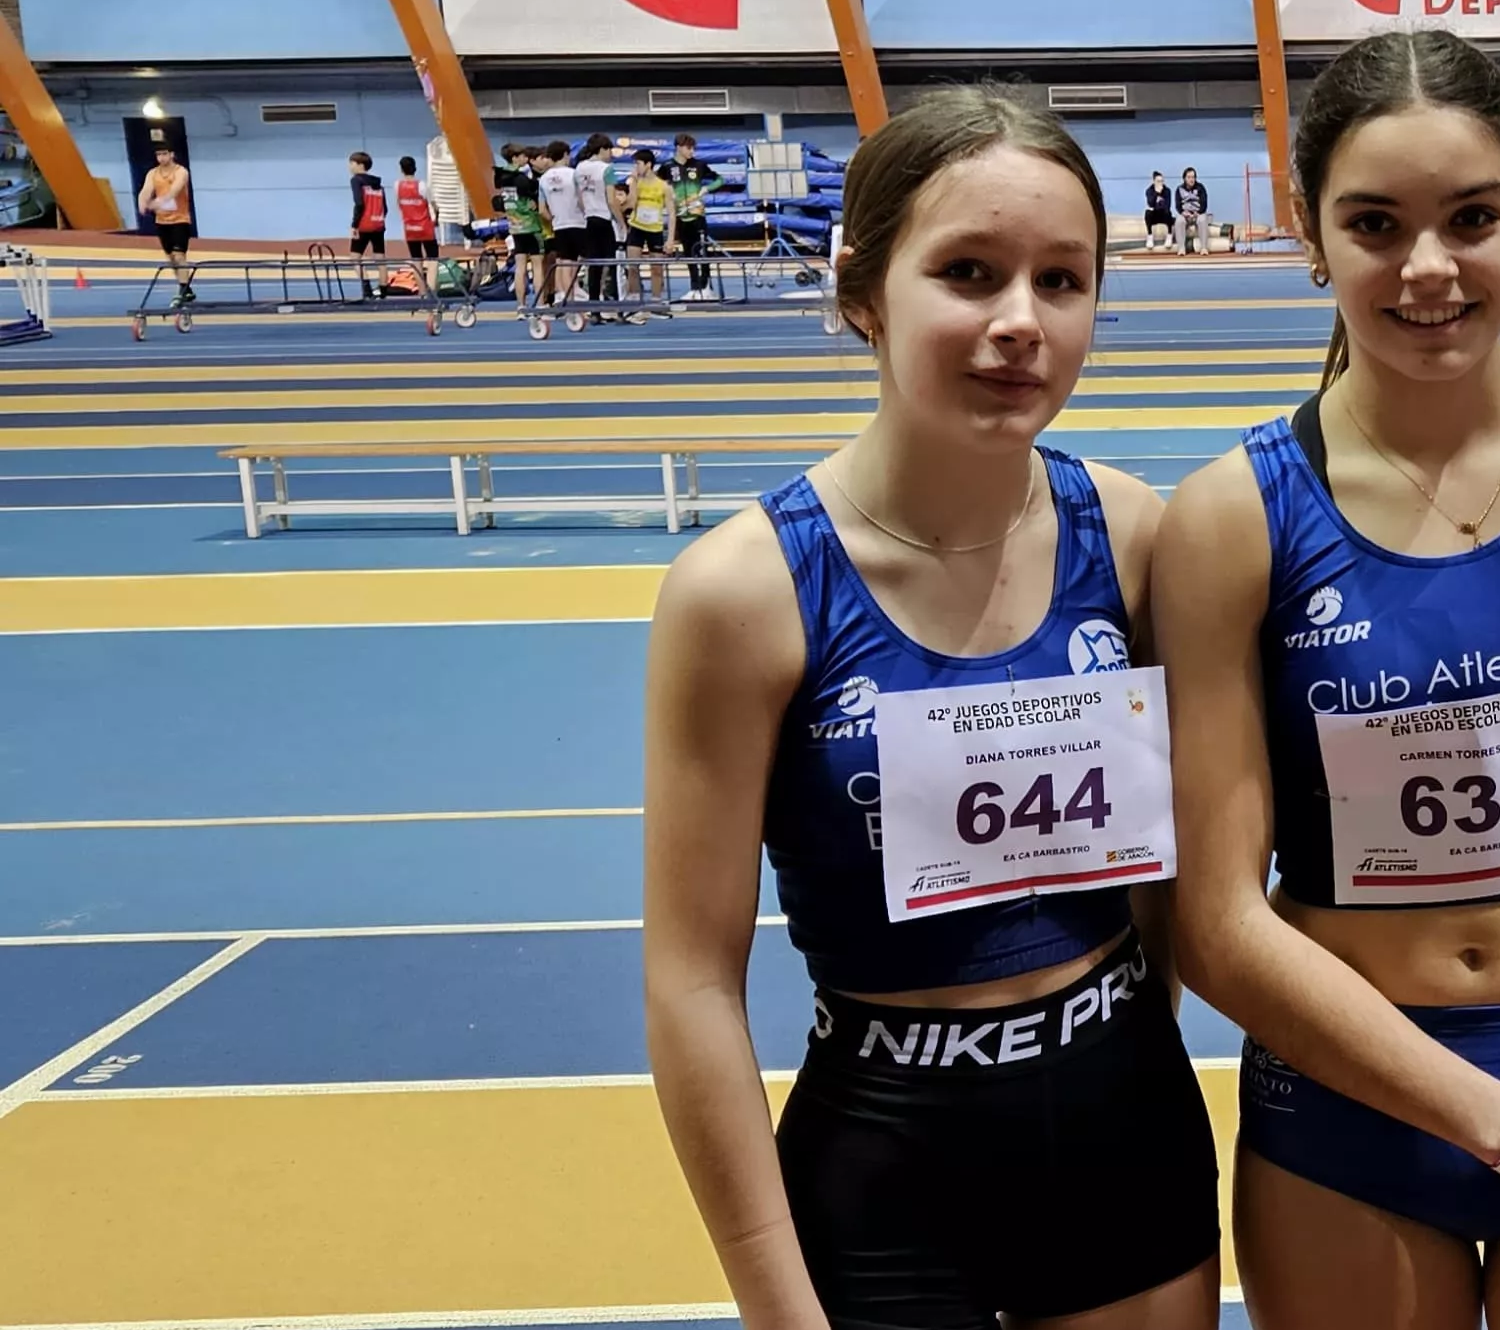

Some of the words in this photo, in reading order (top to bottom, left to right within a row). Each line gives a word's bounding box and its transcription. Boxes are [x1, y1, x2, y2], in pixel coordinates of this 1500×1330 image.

[1284, 620, 1371, 649] VIATOR
[1307, 671, 1411, 715] Club
[955, 701, 1008, 719] JUEGOS
[1013, 692, 1102, 713] DEPORTIVOS
[1393, 709, 1449, 725] JUEGOS
[809, 718, 879, 739] VIAT
[953, 719, 972, 733] EN
[976, 716, 1014, 731] EDAD
[1019, 708, 1081, 726] ESCOLAR
[1391, 724, 1411, 737] EN
[1415, 720, 1454, 733] EDAD
[966, 752, 1005, 765] DIANA
[1009, 746, 1057, 760] TORRES
[1060, 740, 1102, 754] VILLAR
[1400, 750, 1452, 761] CARMEN
[956, 767, 1112, 845] 644
[1003, 854, 1015, 862] EA
[1018, 851, 1031, 860] CA
[1033, 845, 1090, 858] BARBASTRO
[1450, 848, 1462, 856] EA
[1464, 846, 1478, 854] CA
[926, 875, 971, 890] ATLETISMO
[859, 1012, 1046, 1066] NIKE
